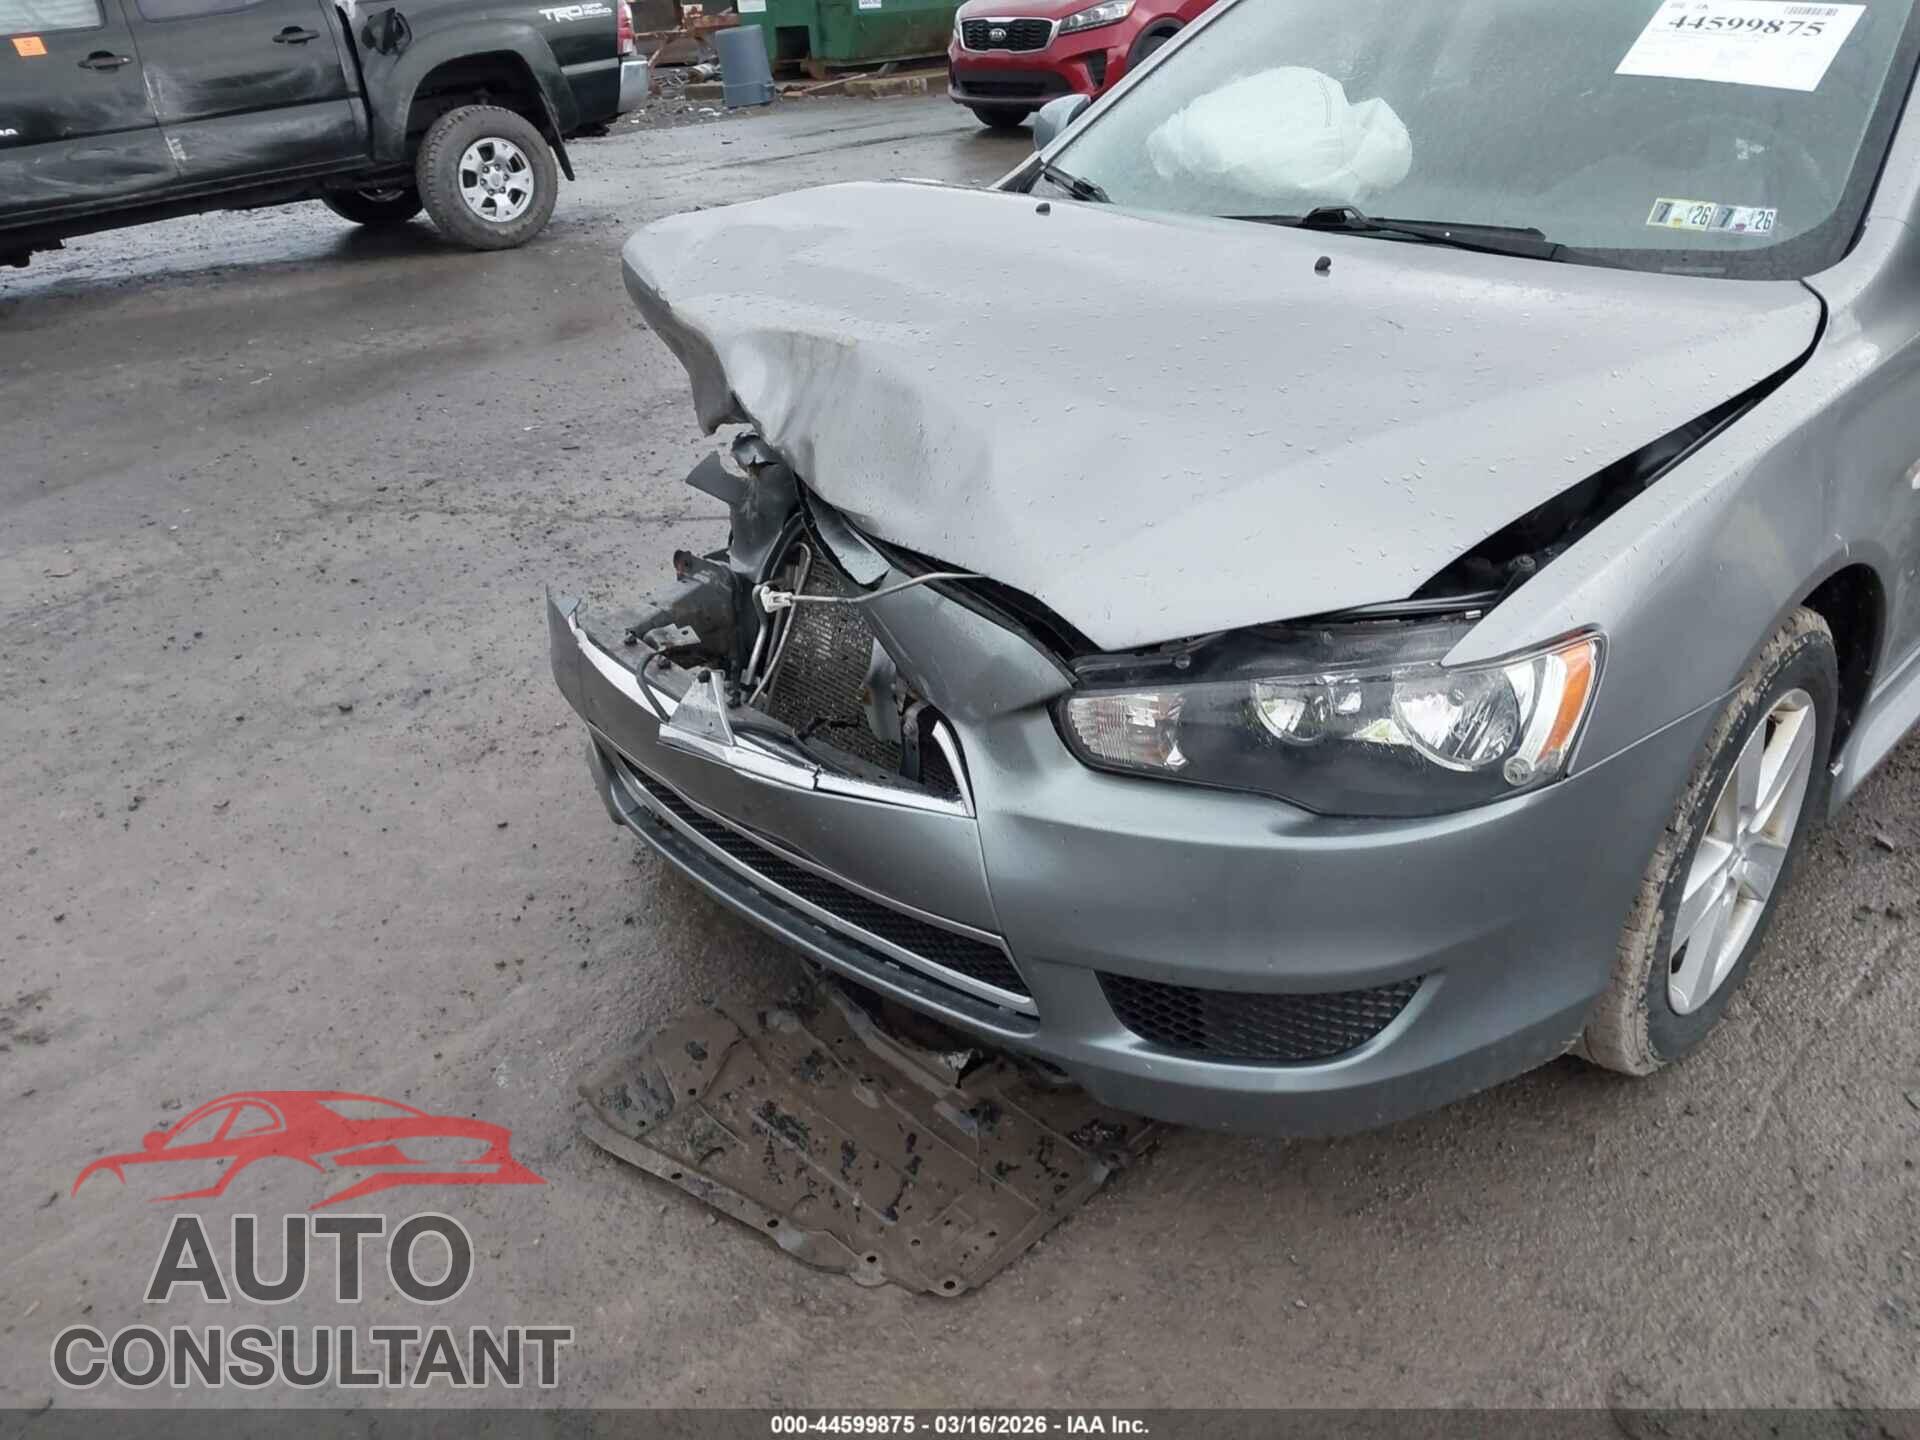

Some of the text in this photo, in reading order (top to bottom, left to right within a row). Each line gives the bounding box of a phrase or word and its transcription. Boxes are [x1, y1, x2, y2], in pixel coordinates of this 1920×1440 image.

[539, 5, 583, 22] TRD
[1668, 15, 1828, 37] 44599875
[1657, 202, 1712, 225] 7 26
[1720, 208, 1774, 230] 7 26
